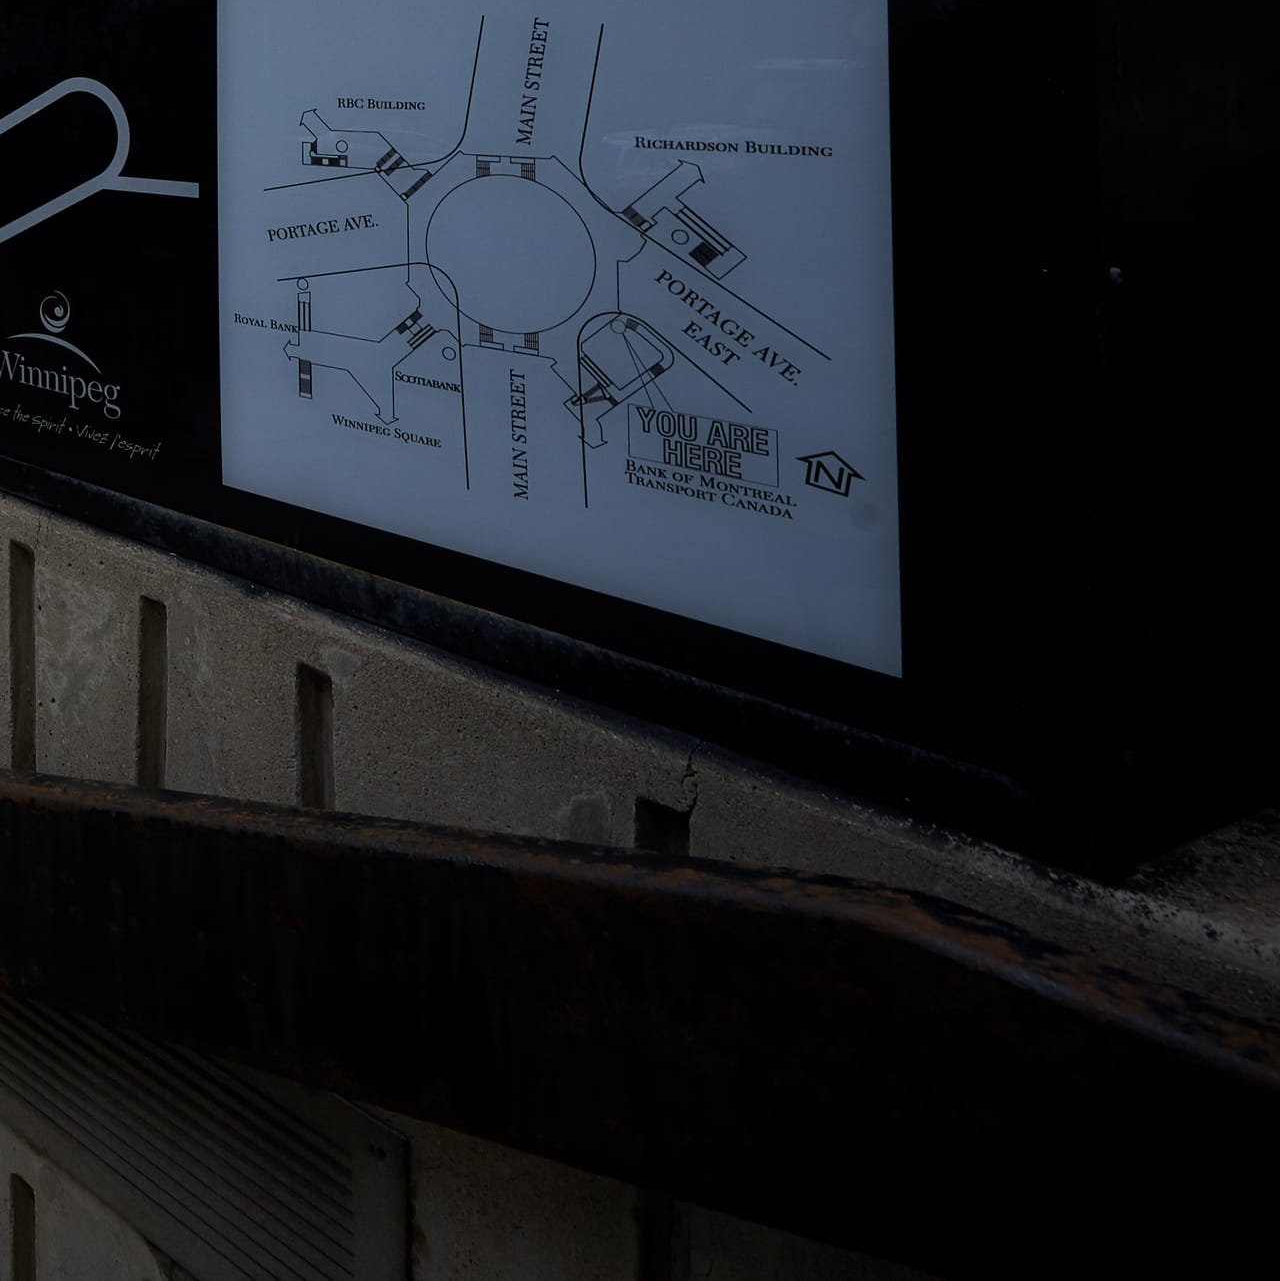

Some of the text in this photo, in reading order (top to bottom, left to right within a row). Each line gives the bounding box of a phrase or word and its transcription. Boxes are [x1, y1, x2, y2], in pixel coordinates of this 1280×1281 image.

[337, 97, 364, 109] RBC
[515, 16, 550, 146] MAIN STREET
[267, 214, 380, 242] PORTAGE AVE.
[654, 268, 802, 387] PORTAGE AVE.
[680, 320, 741, 367] EAST
[11, 403, 30, 423] the
[75, 424, 109, 445] Vivez
[509, 368, 530, 501] MAIN STREET
[635, 406, 770, 457] YOU ARE
[662, 438, 743, 480] HERE
